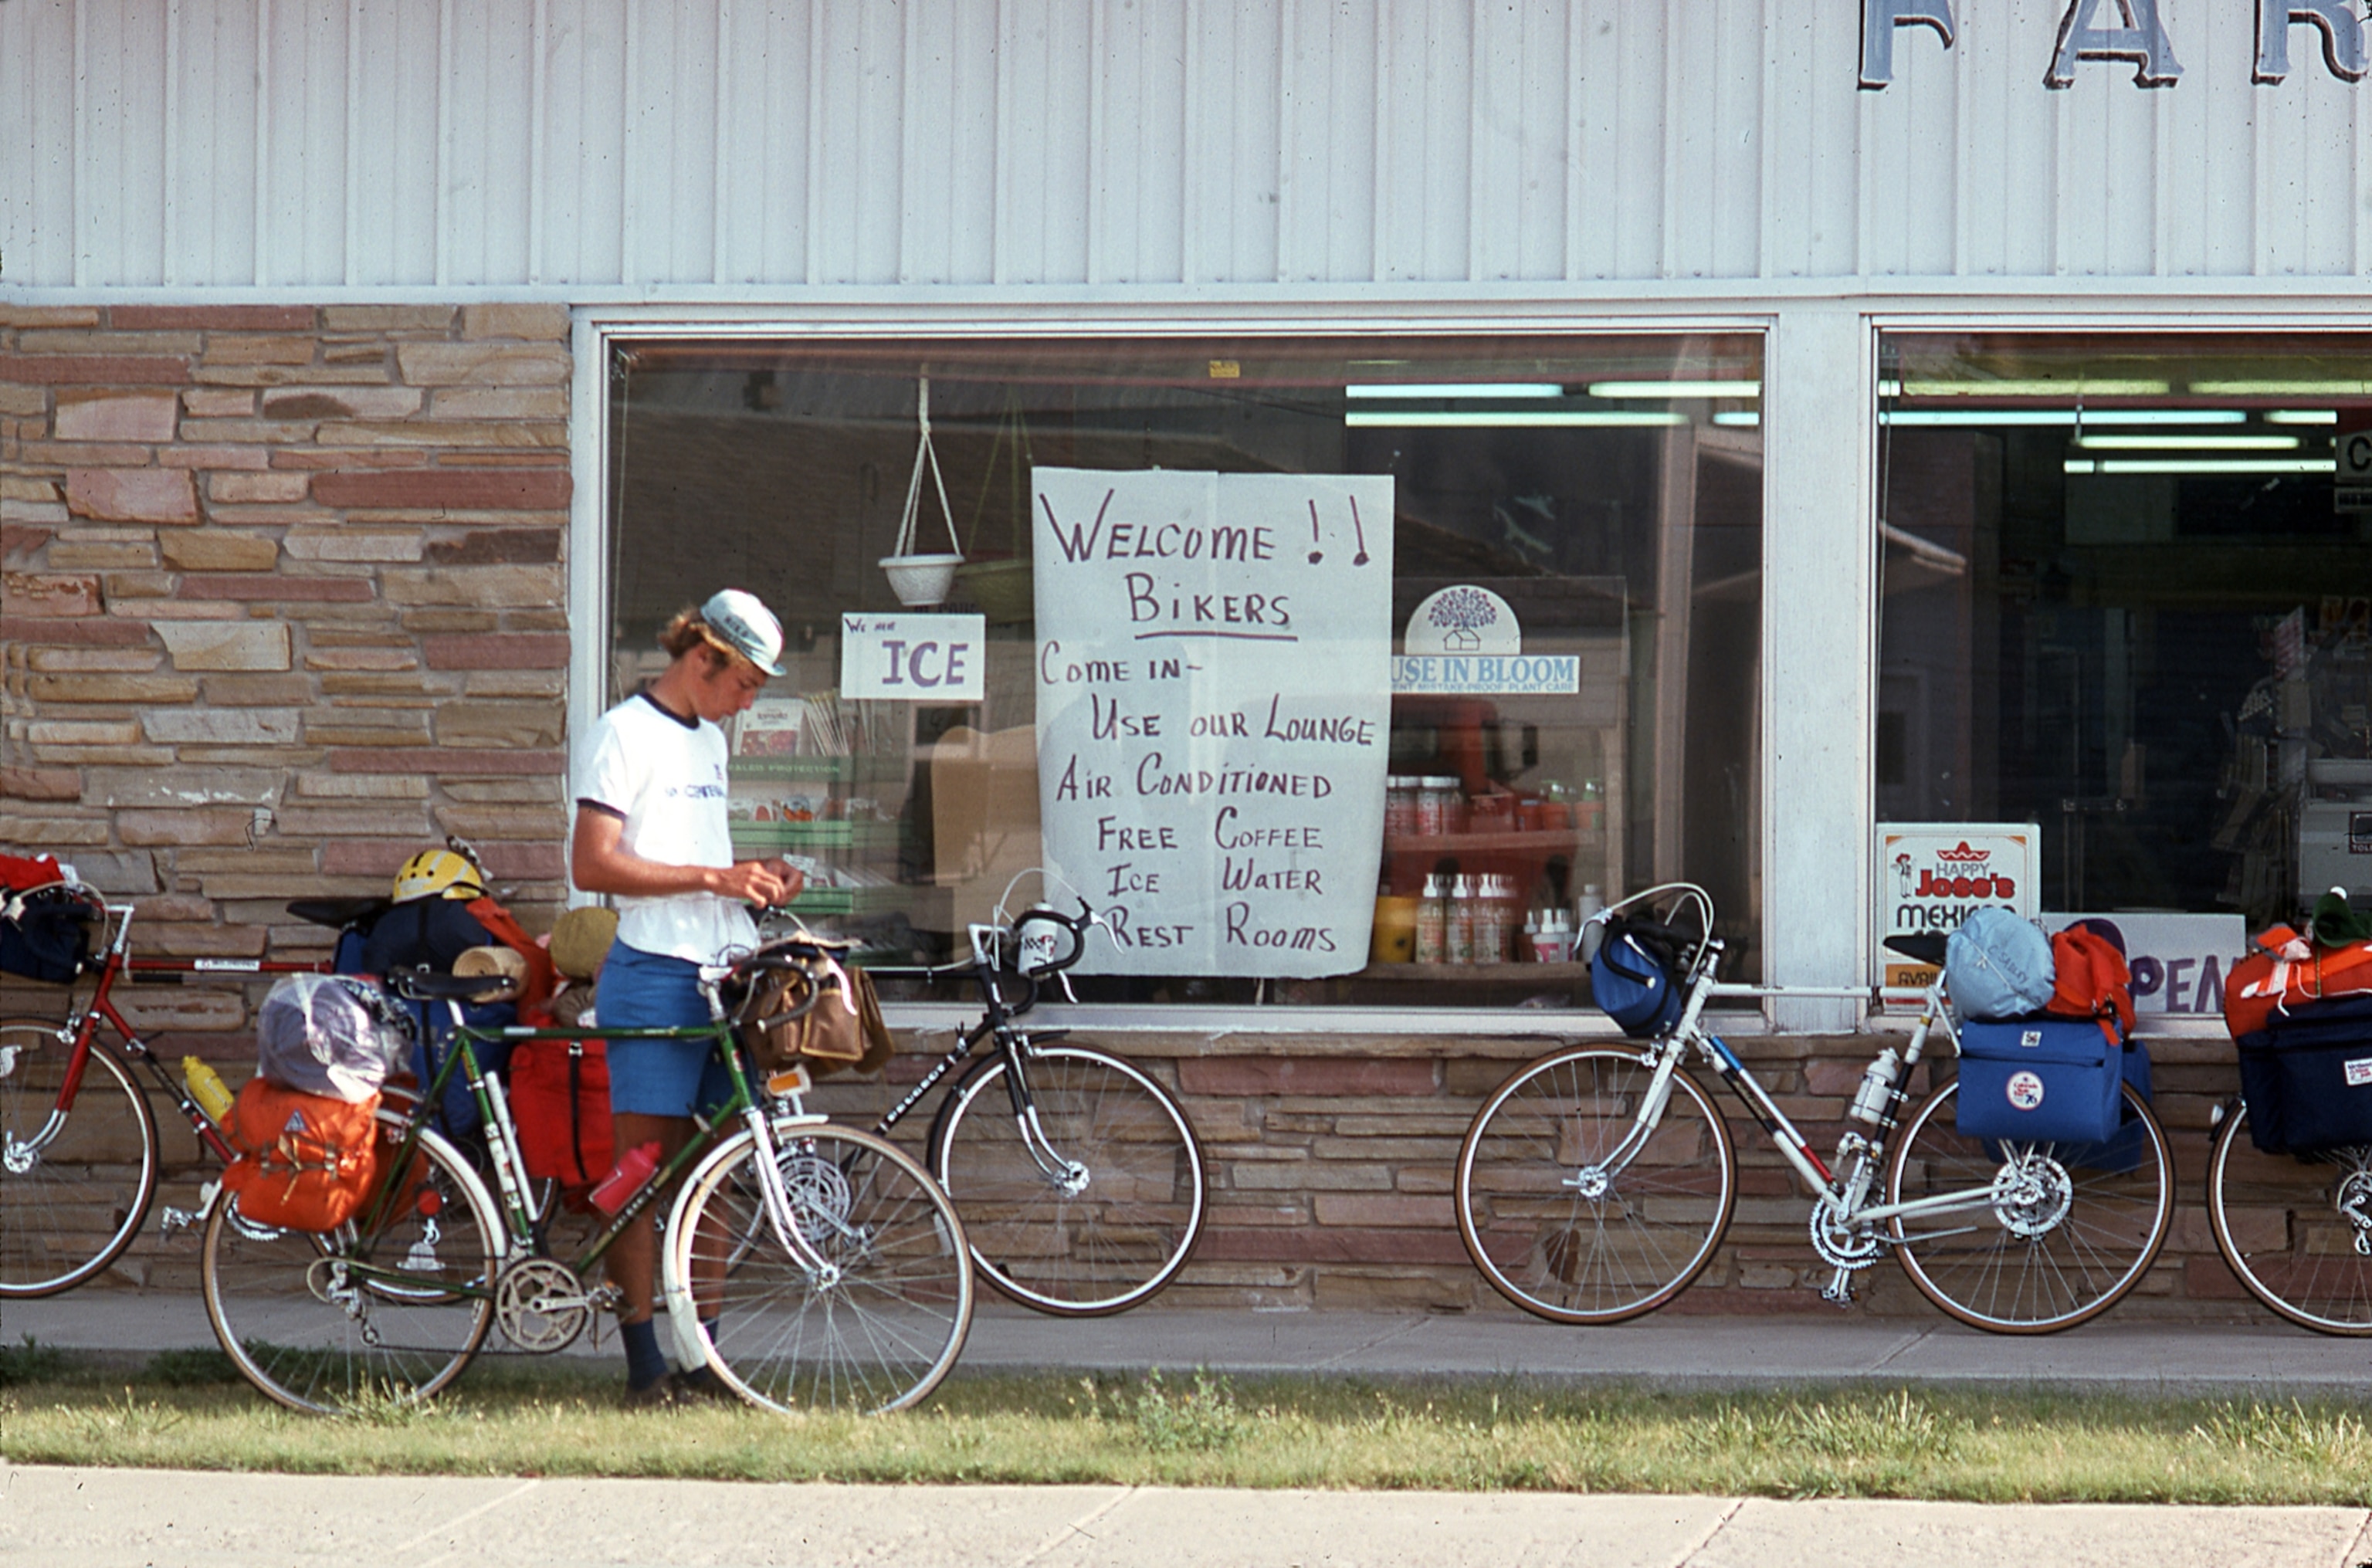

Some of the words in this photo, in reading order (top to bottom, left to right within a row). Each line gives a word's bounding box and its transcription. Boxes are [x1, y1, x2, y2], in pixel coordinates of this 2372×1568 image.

[1039, 488, 1276, 563] WELCOME
[882, 640, 968, 687] ICE
[1042, 641, 1130, 684] COME
[1442, 657, 1470, 682] IN
[1478, 657, 1574, 683] BLOOM
[1509, 683, 1542, 692] PLANT
[1546, 683, 1574, 692] CARE
[1091, 693, 1161, 741] USE
[1190, 711, 1249, 738] OUR
[1264, 693, 1376, 745] LOUNGE
[1098, 815, 1179, 850] FREE
[1214, 806, 1323, 849] COFFEE
[1106, 863, 1161, 897] ICE
[1915, 869, 2016, 899] Jose's
[1937, 862, 1991, 877] HAPPY
[1102, 905, 1194, 947] REST
[1226, 901, 1337, 951] ROOMS
[886, 1062, 945, 1123] PEUGEOT
